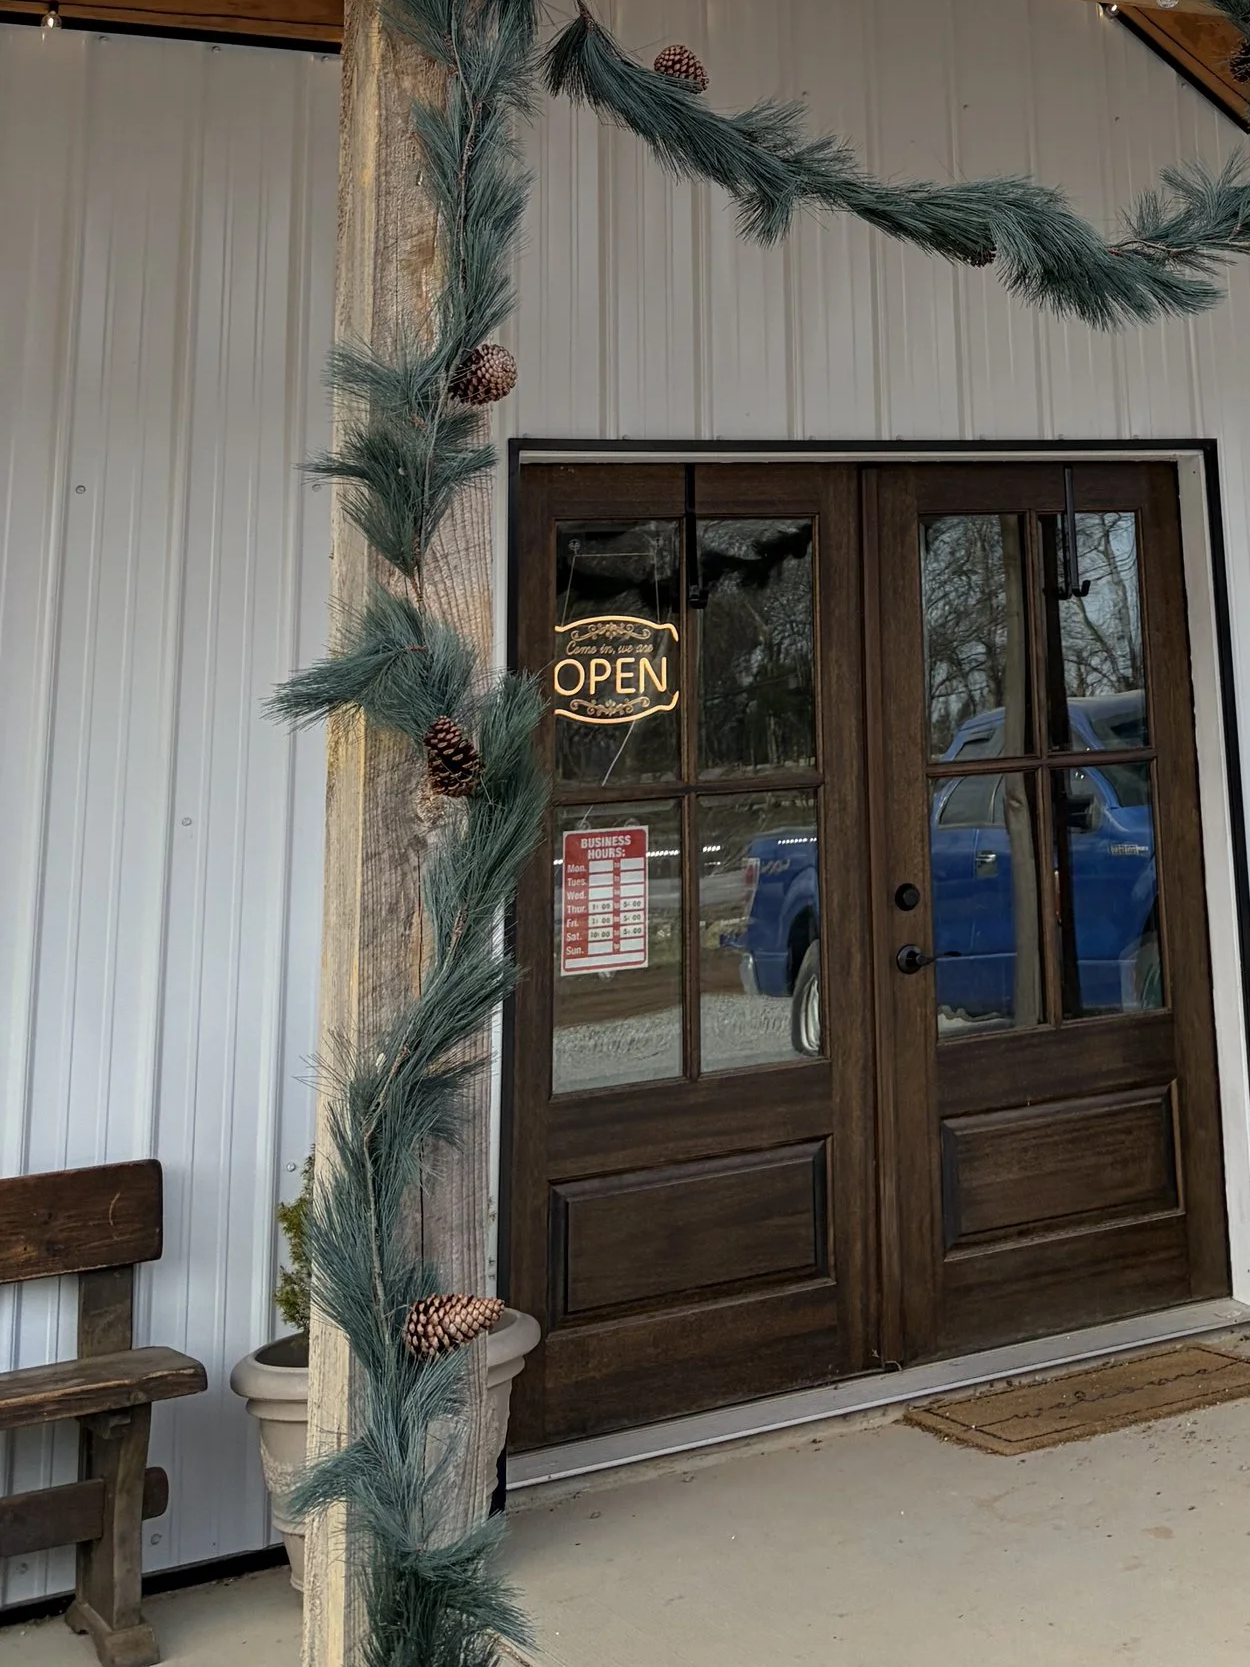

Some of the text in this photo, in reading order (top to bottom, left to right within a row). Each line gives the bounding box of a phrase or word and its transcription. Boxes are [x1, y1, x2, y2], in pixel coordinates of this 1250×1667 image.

[566, 640, 598, 655] Come
[618, 643, 634, 654] we
[636, 643, 654, 654] are
[554, 657, 667, 696] OPEN
[580, 835, 632, 849] BUSINESS
[587, 847, 626, 859] HOURS:
[567, 865, 587, 873] Mon.
[567, 878, 587, 887] Tues.
[567, 891, 587, 900] Wed.
[567, 905, 587, 914] Thur.
[566, 919, 579, 928] Fri.
[566, 932, 583, 942] Sat.
[566, 945, 584, 955] Sun.
